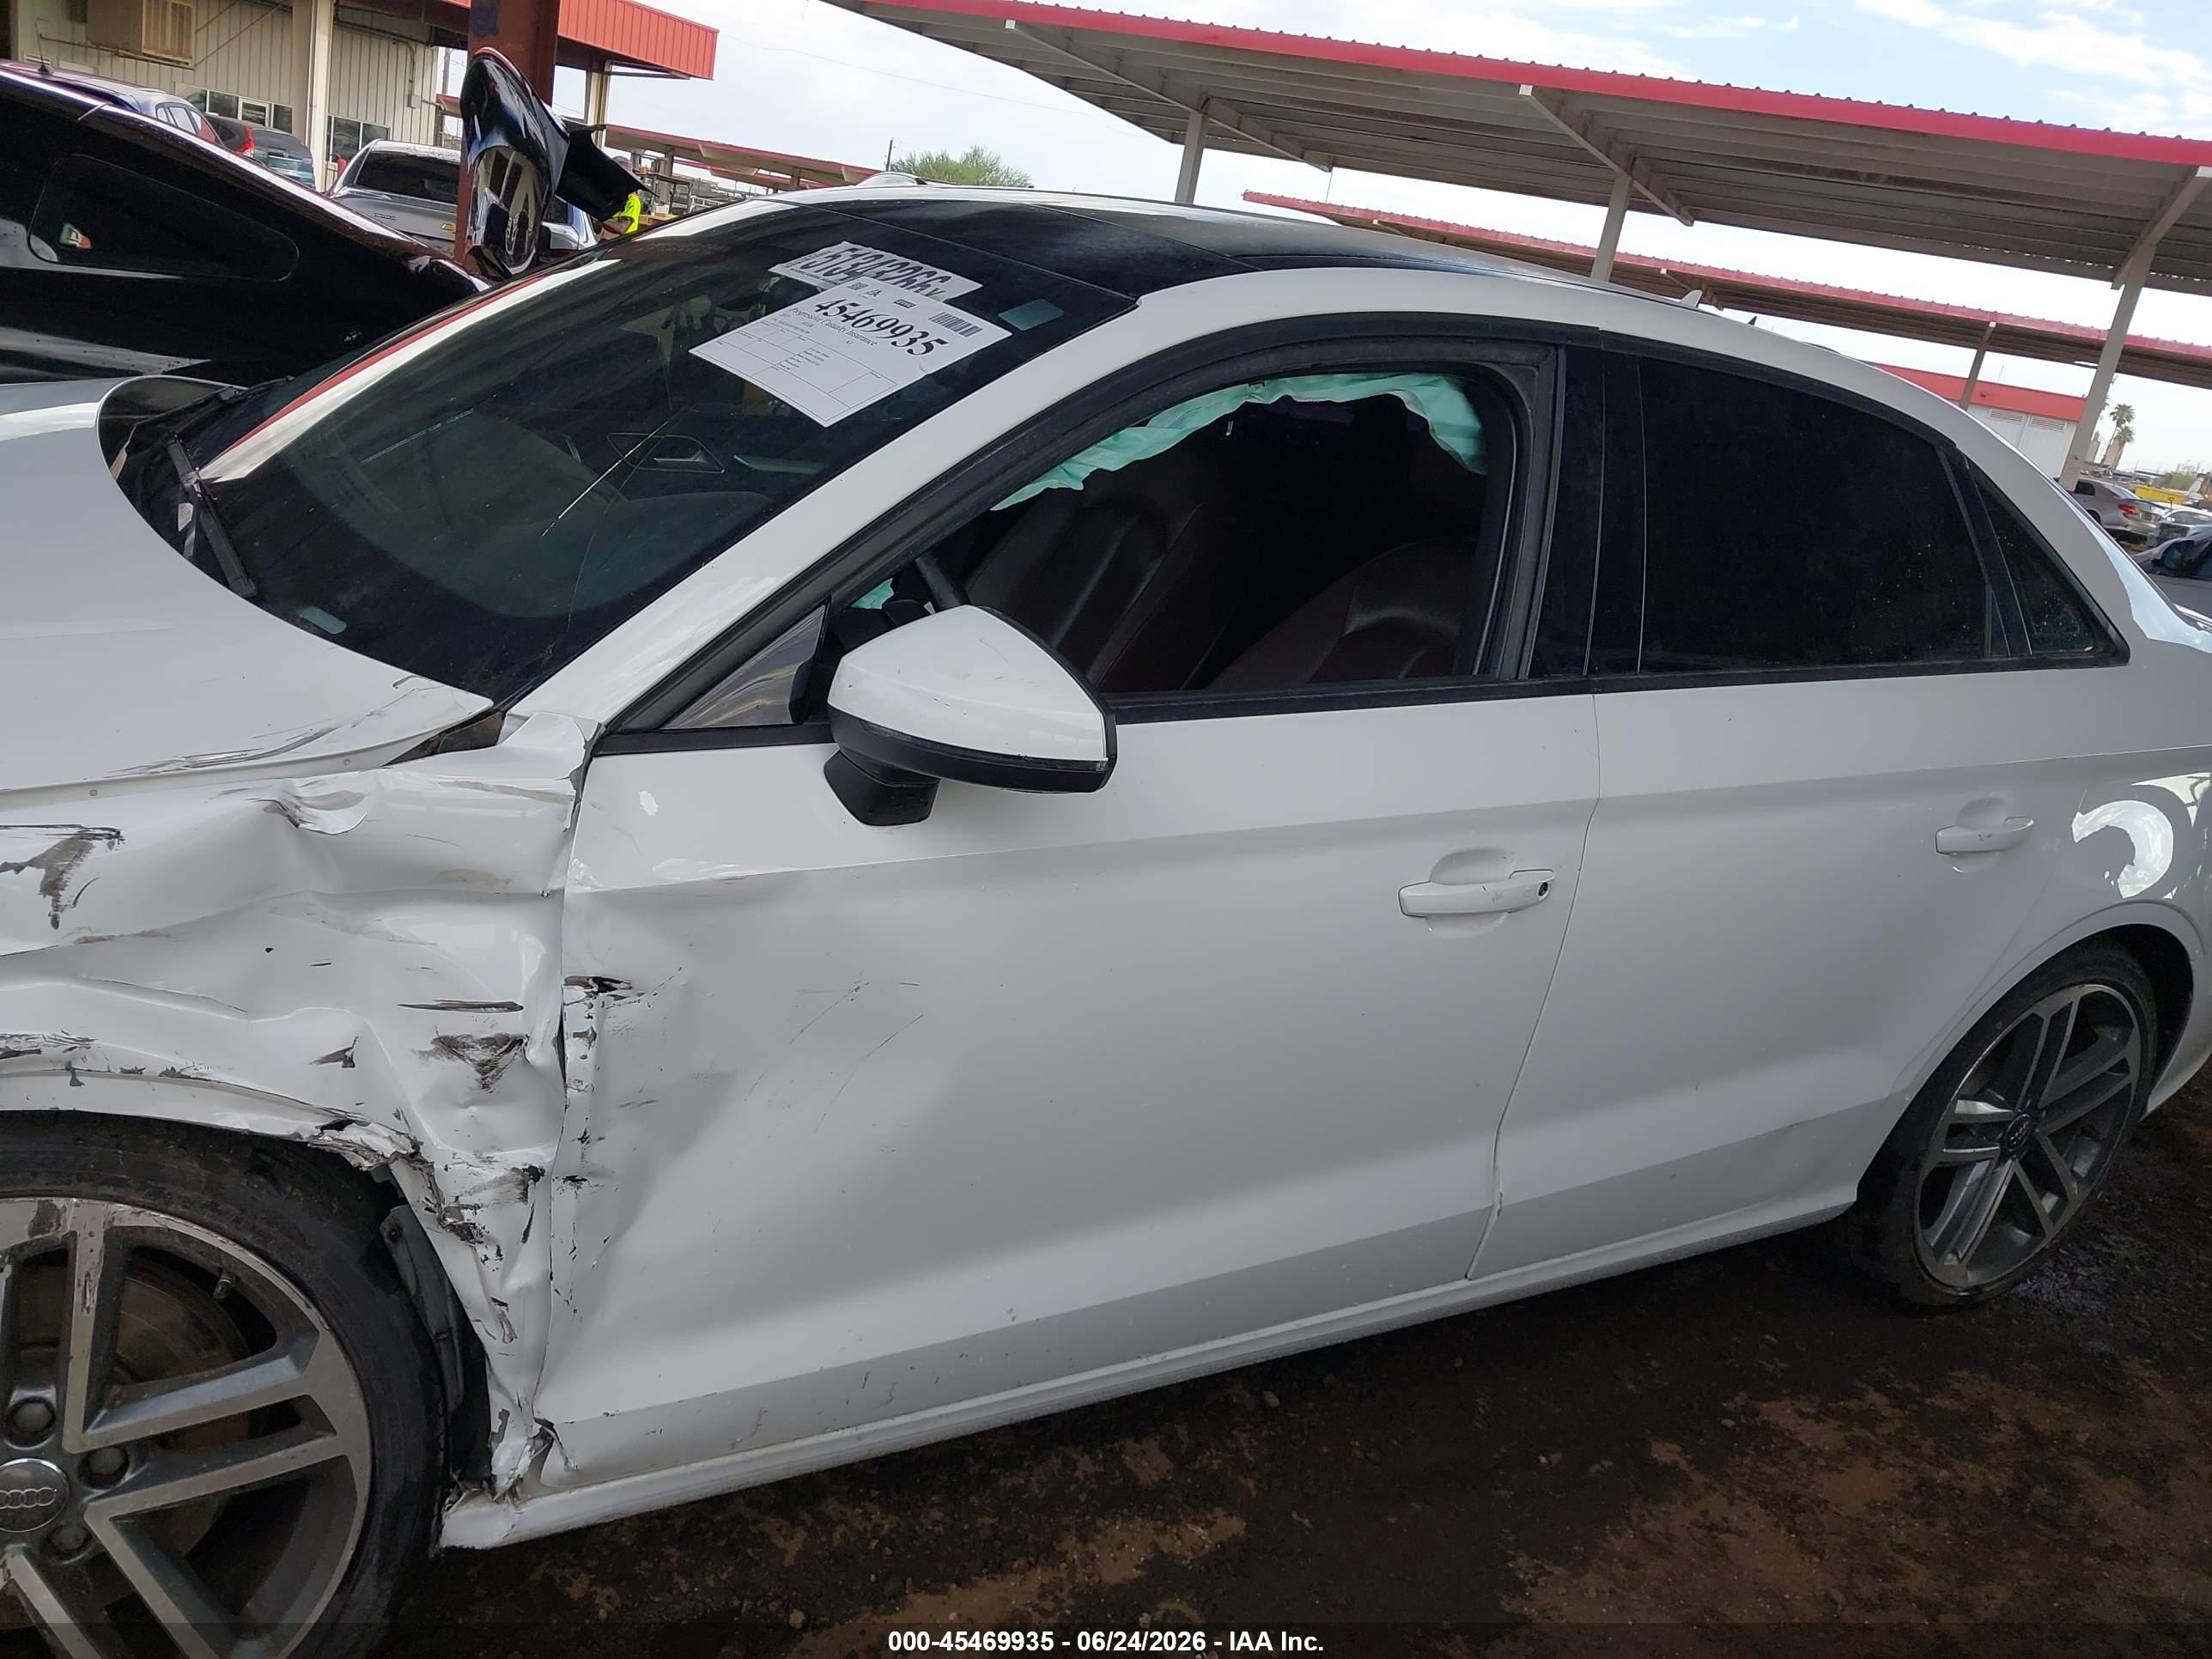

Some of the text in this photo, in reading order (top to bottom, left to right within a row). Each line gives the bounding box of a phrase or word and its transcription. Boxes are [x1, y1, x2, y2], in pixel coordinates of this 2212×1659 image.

[789, 307, 823, 324] Progressive
[820, 319, 847, 333] Casualty
[846, 329, 878, 346] Insurance
[814, 298, 948, 356] 45469935
